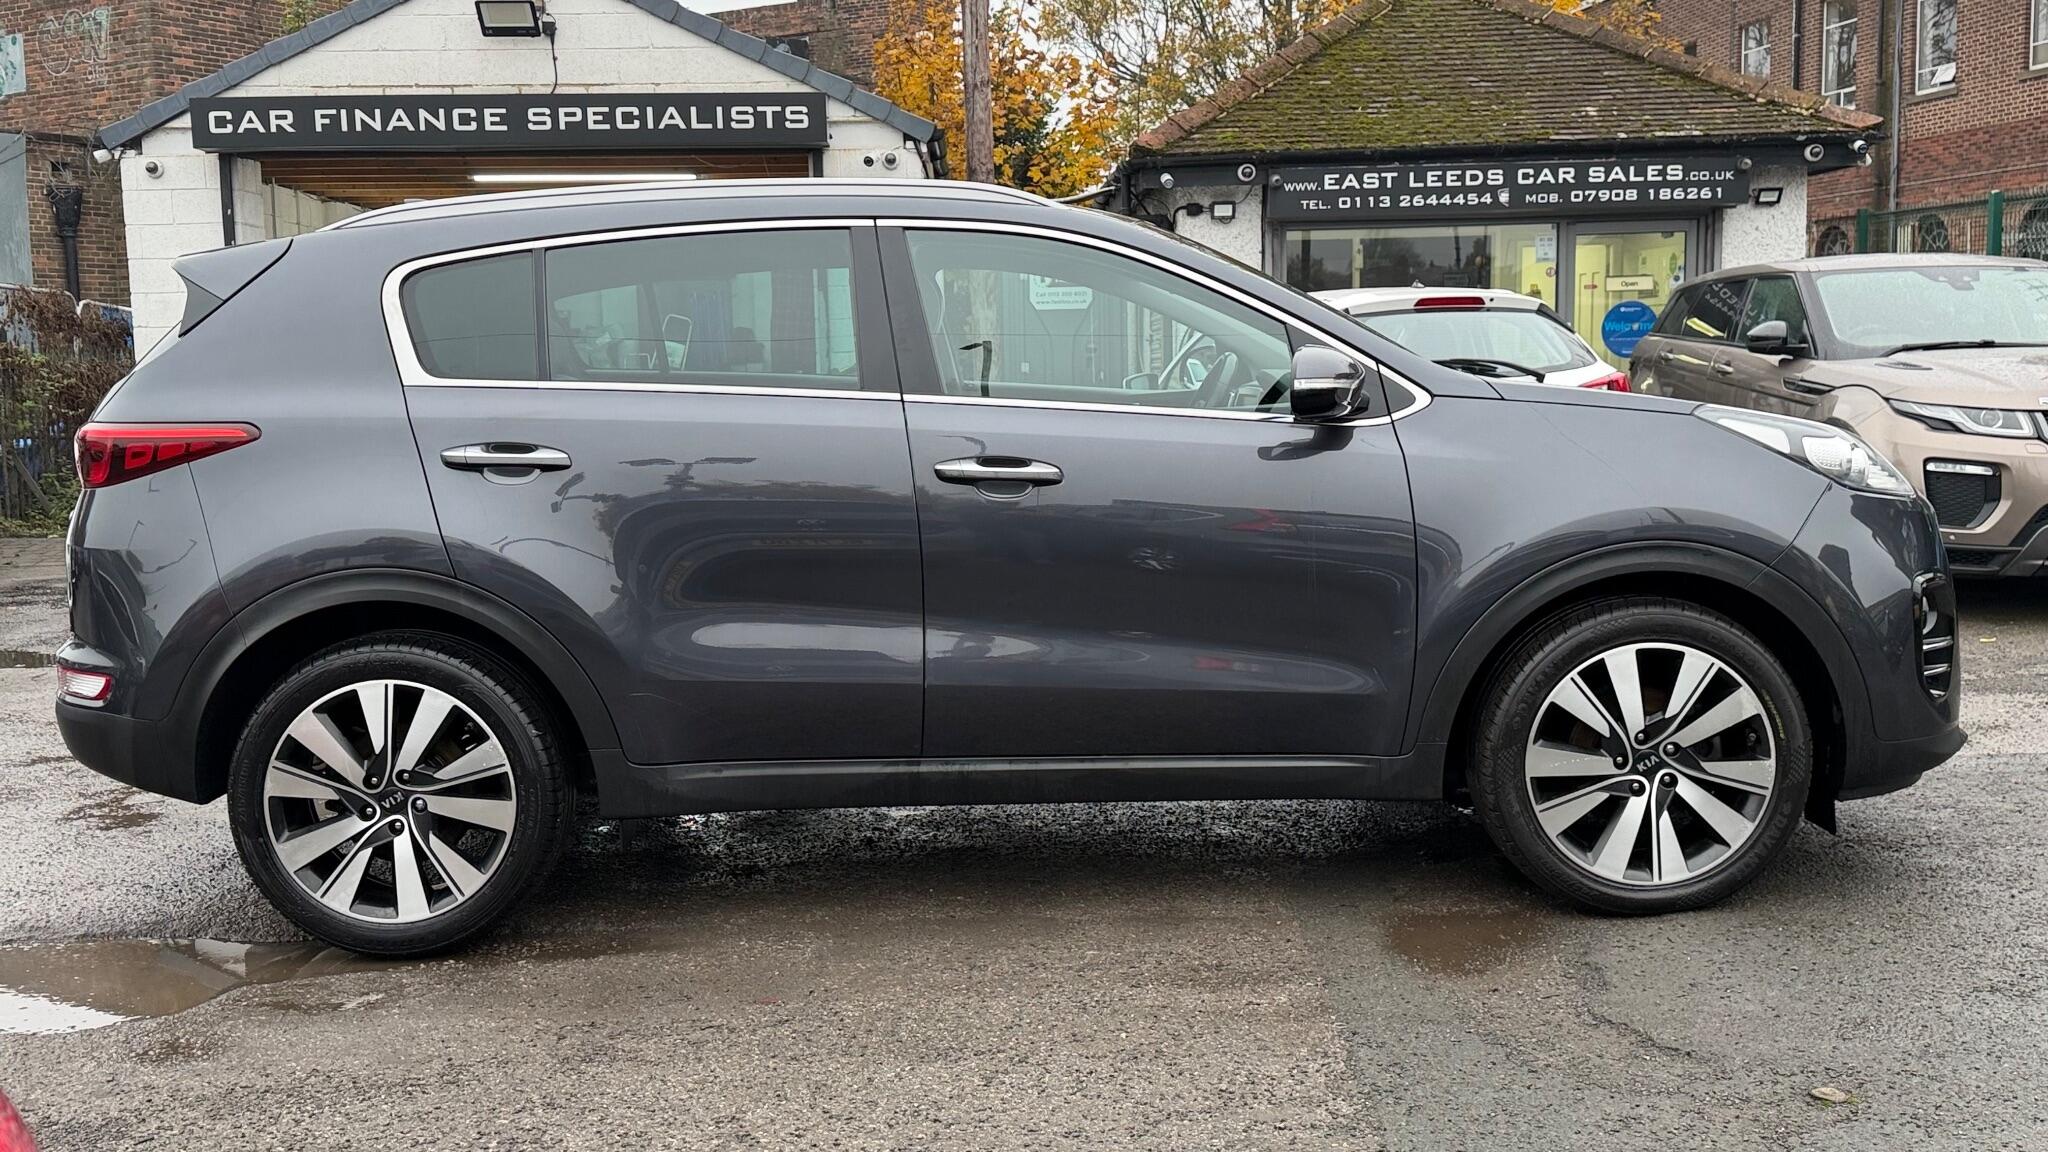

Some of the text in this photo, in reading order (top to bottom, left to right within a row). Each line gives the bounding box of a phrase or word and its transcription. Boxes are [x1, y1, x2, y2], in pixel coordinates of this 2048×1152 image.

[207, 105, 811, 134] CAR FINANCE SPECIALISTS
[1409, 169, 1504, 188] LEEDS
[1517, 167, 1576, 185] CAR
[1301, 187, 1723, 210] TEL. 0113 2644454 MOB. 07908 186261
[1620, 280, 1639, 288] Open
[1636, 755, 1660, 772] KIA
[381, 791, 405, 808] KIA
